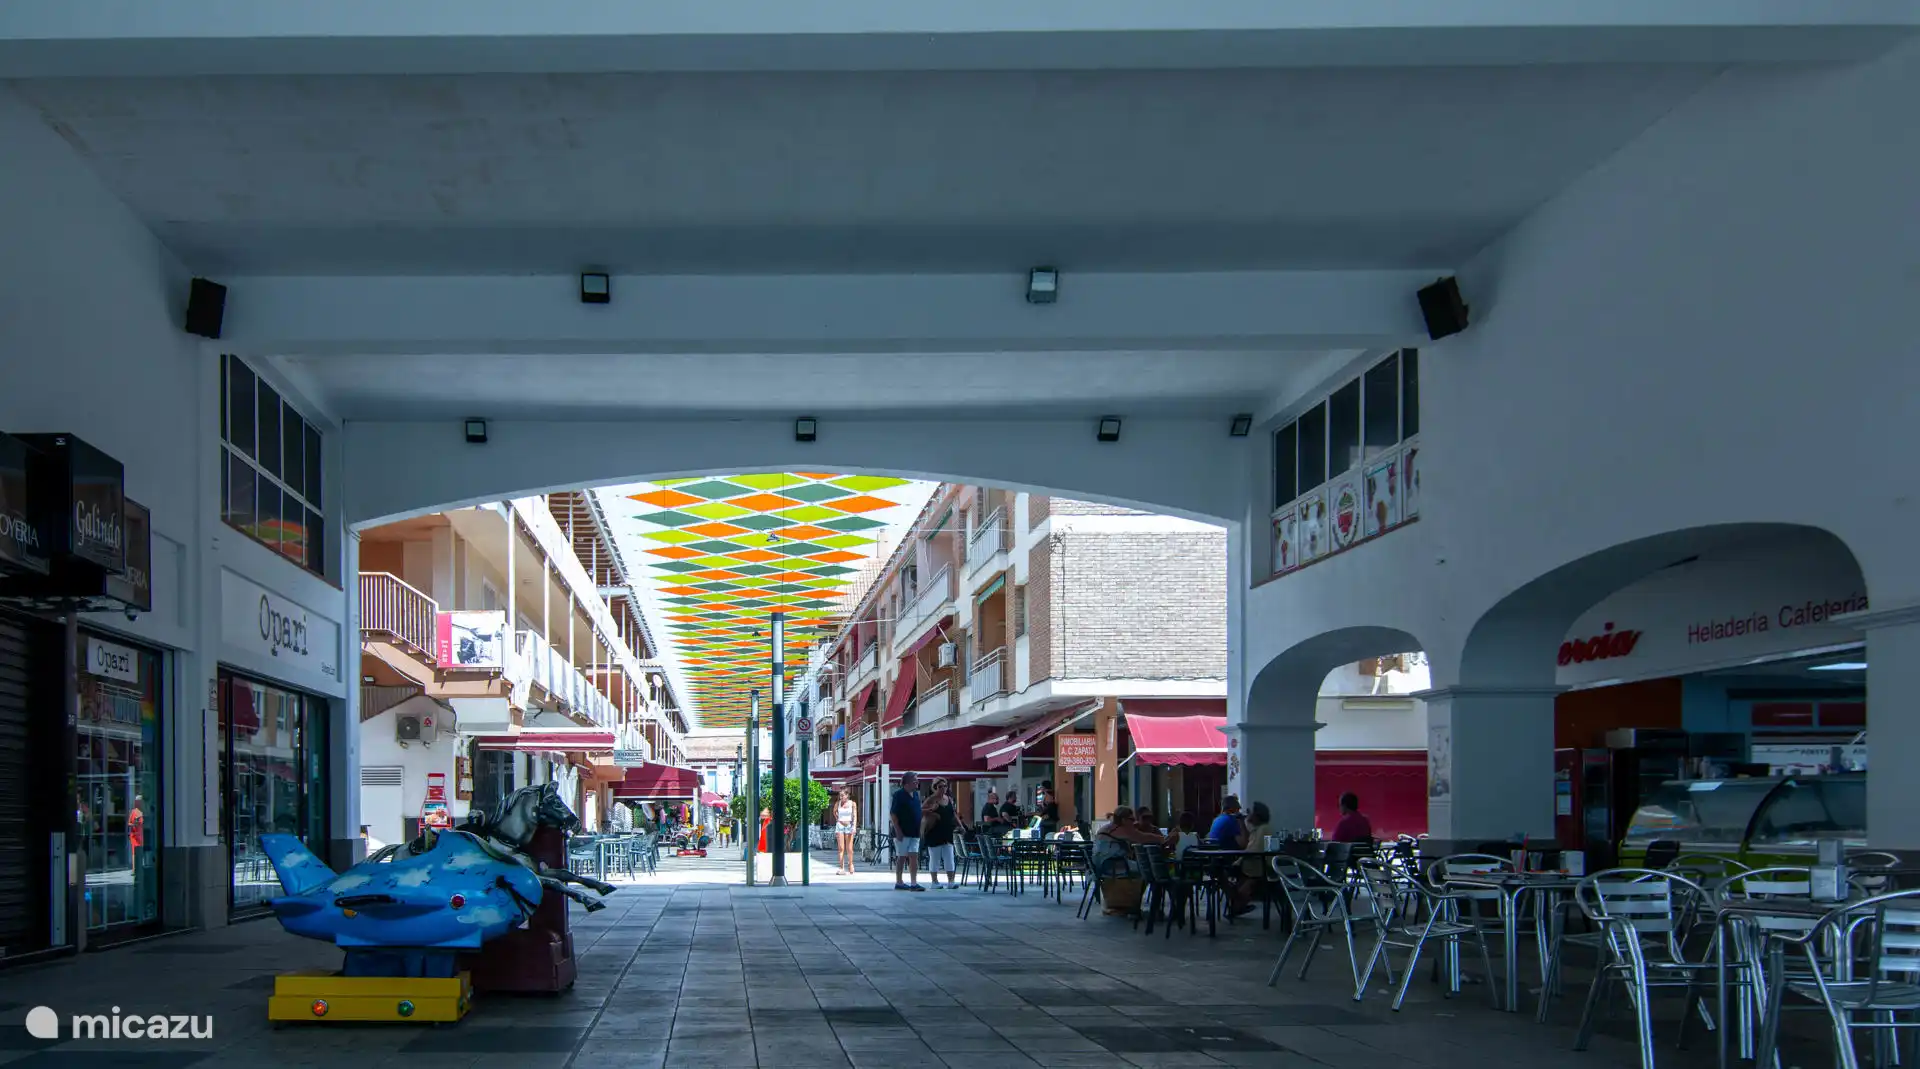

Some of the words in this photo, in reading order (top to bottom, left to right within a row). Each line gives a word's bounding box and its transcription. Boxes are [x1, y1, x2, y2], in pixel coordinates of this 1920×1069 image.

[76, 500, 121, 549] Galindo
[259, 594, 308, 657] Opari
[1688, 612, 1769, 644] Heladería
[97, 645, 129, 673] Opari
[1074, 746, 1095, 755] ZAPATA
